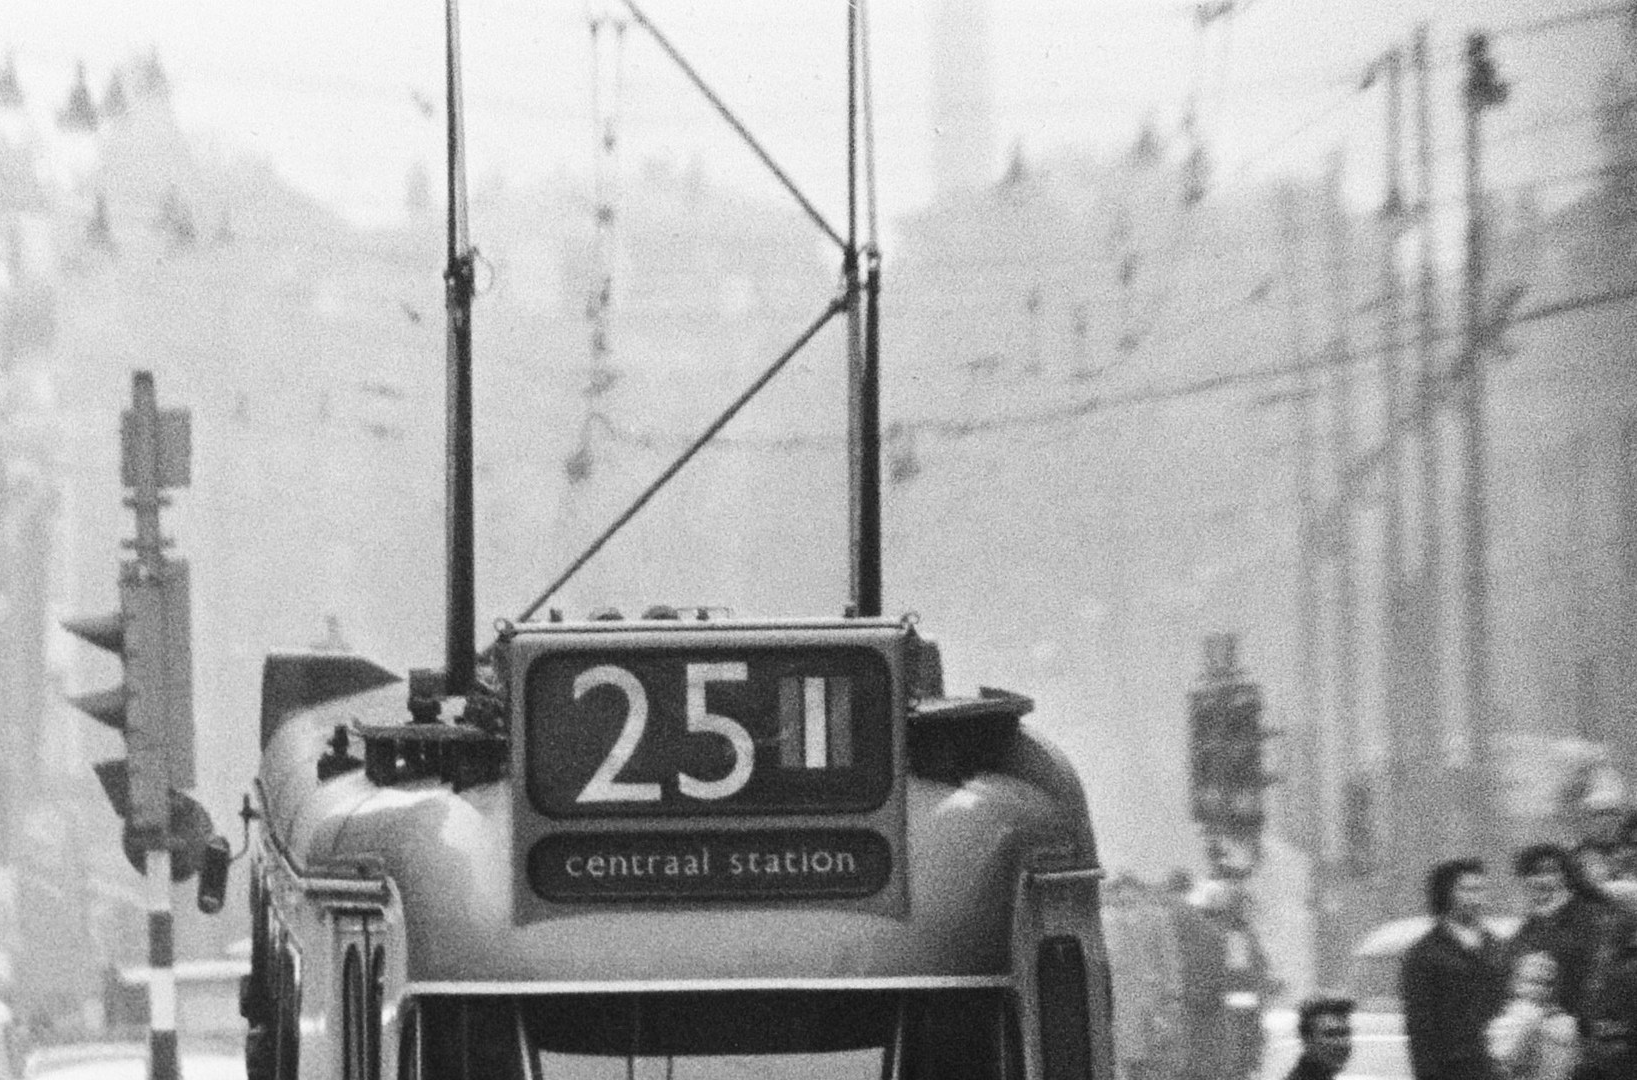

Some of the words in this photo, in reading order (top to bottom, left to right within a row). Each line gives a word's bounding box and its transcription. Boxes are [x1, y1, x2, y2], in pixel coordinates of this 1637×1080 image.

[572, 661, 755, 803] 25
[565, 847, 710, 877] centraal
[728, 849, 857, 877] station
